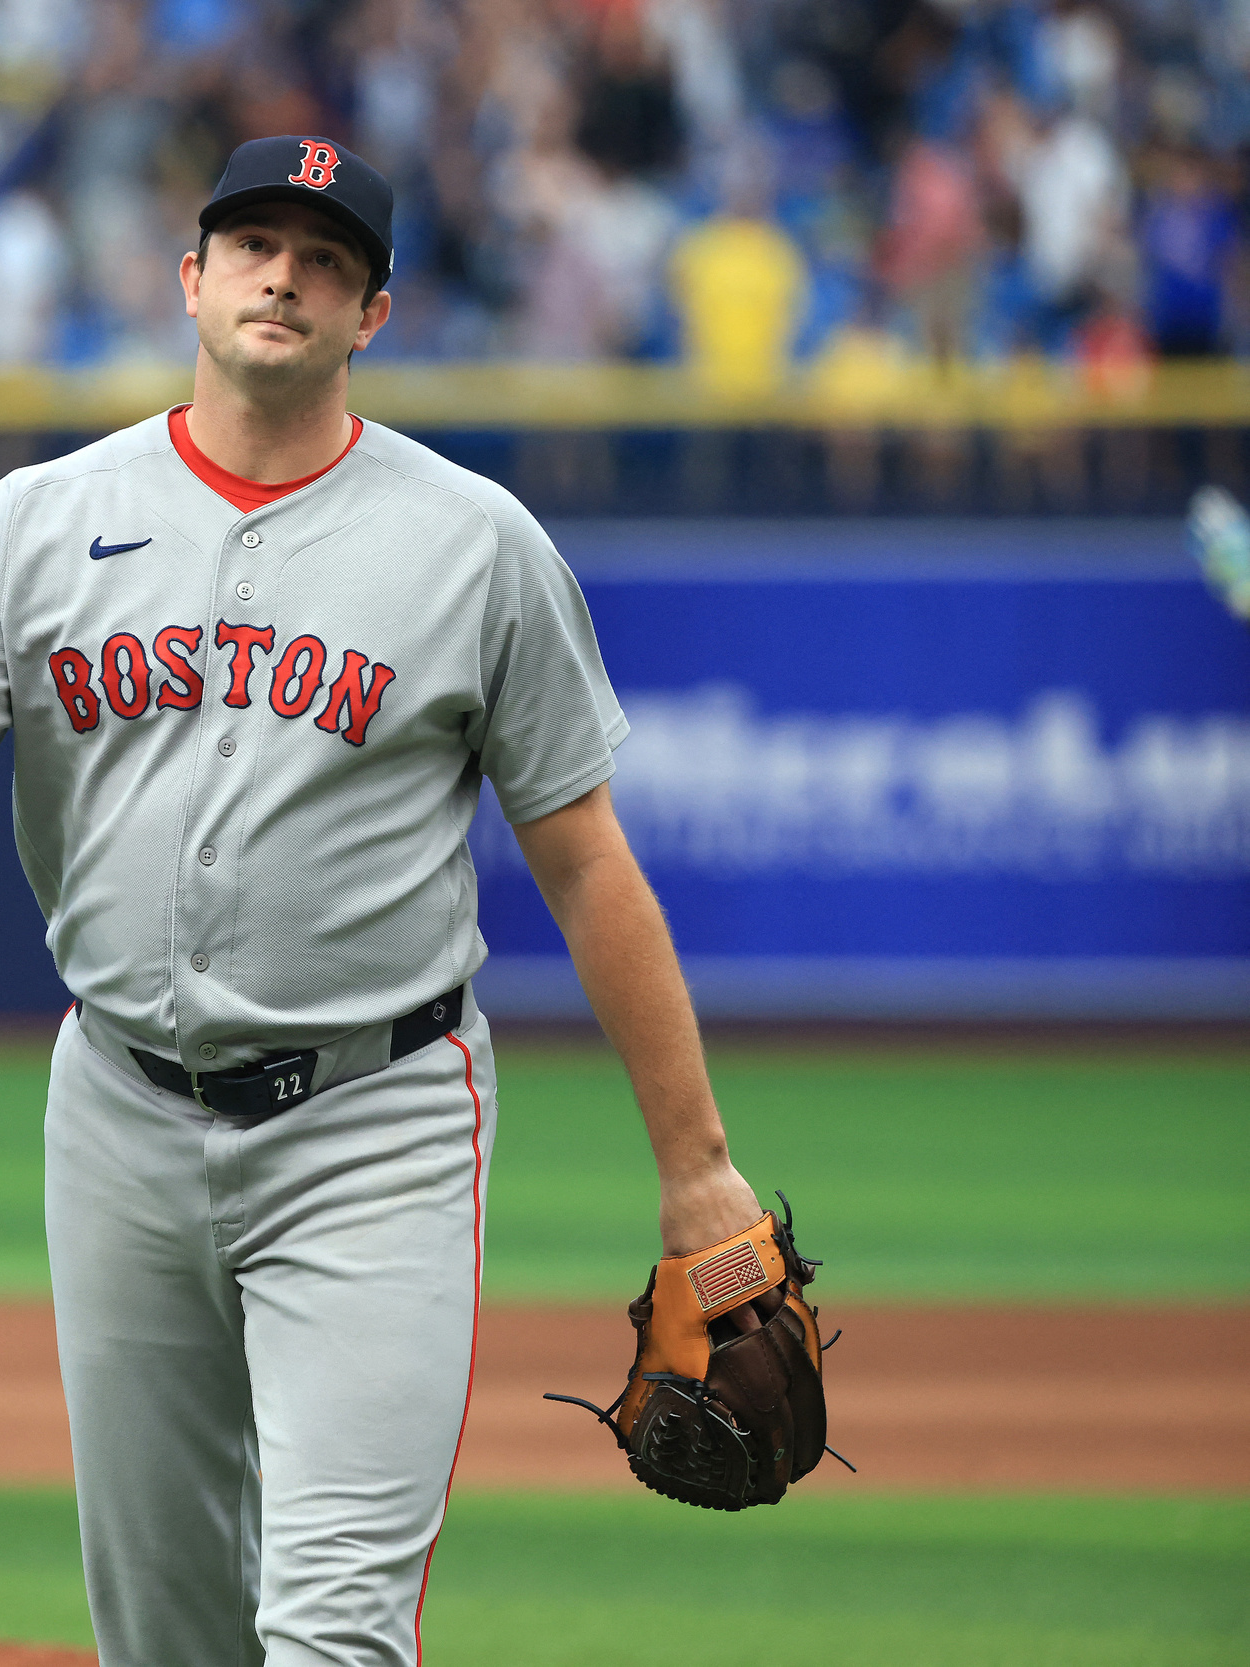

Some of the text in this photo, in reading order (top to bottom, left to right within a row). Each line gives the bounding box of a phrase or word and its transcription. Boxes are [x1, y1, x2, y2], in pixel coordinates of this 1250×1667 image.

[288, 139, 342, 191] B
[49, 618, 397, 747] BOSTON
[274, 1072, 303, 1101] 22
